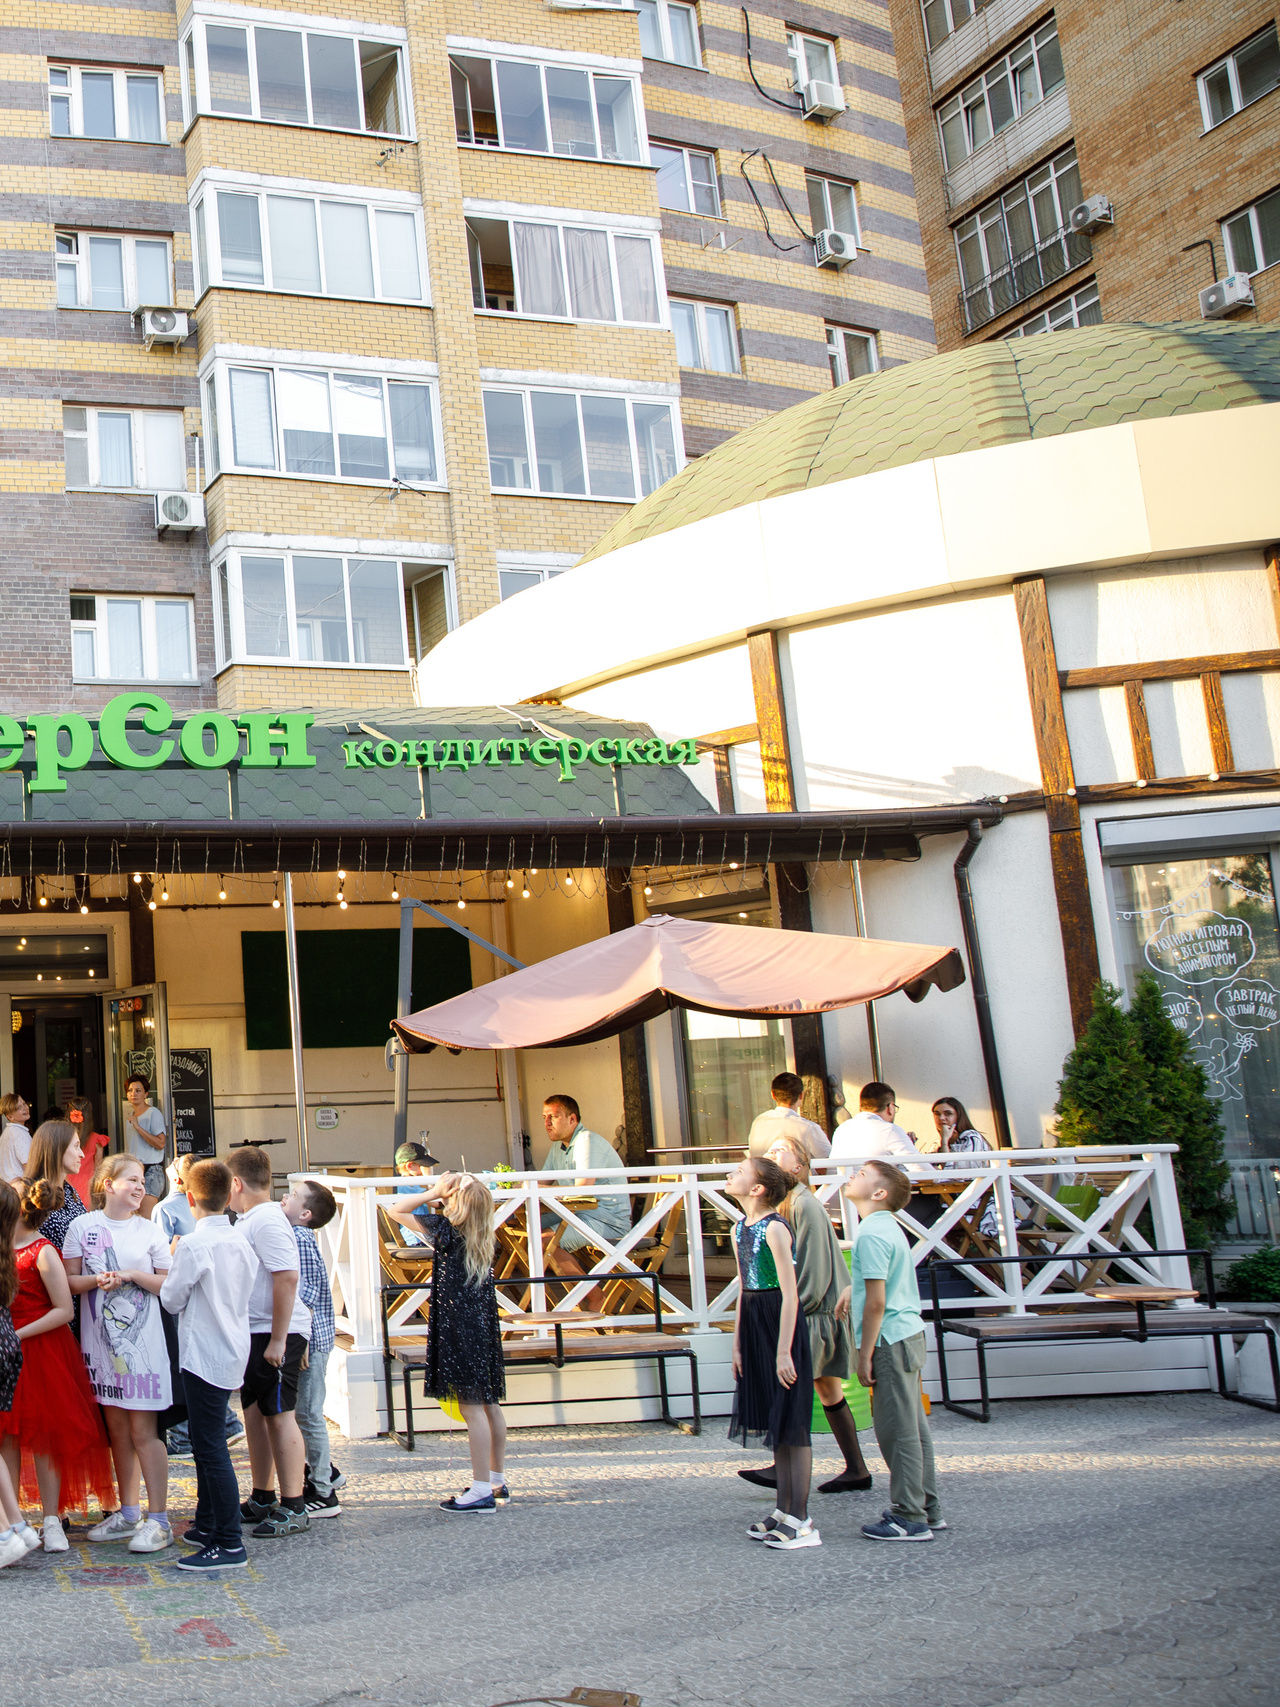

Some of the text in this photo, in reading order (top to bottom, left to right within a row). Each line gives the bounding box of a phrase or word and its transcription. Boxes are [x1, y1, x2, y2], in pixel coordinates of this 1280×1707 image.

[342, 737, 701, 783] кондитерская
[1153, 924, 1243, 953] УЮТНАЯ ИГРОВАЯ
[1172, 939, 1230, 960] С ВЕСЕЛЫМ
[1177, 952, 1237, 975] АНИМАТОРОМ
[1225, 989, 1277, 1005] ЗАВТРАК
[1163, 1001, 1192, 1018] СНОЕ
[1225, 1002, 1277, 1020] ЦЕЛЫЙ ДЕНЬ
[170, 1055, 205, 1077] РАЗДНИКИ
[177, 1108, 195, 1116] гостей
[114, 1373, 162, 1399] ZONE
